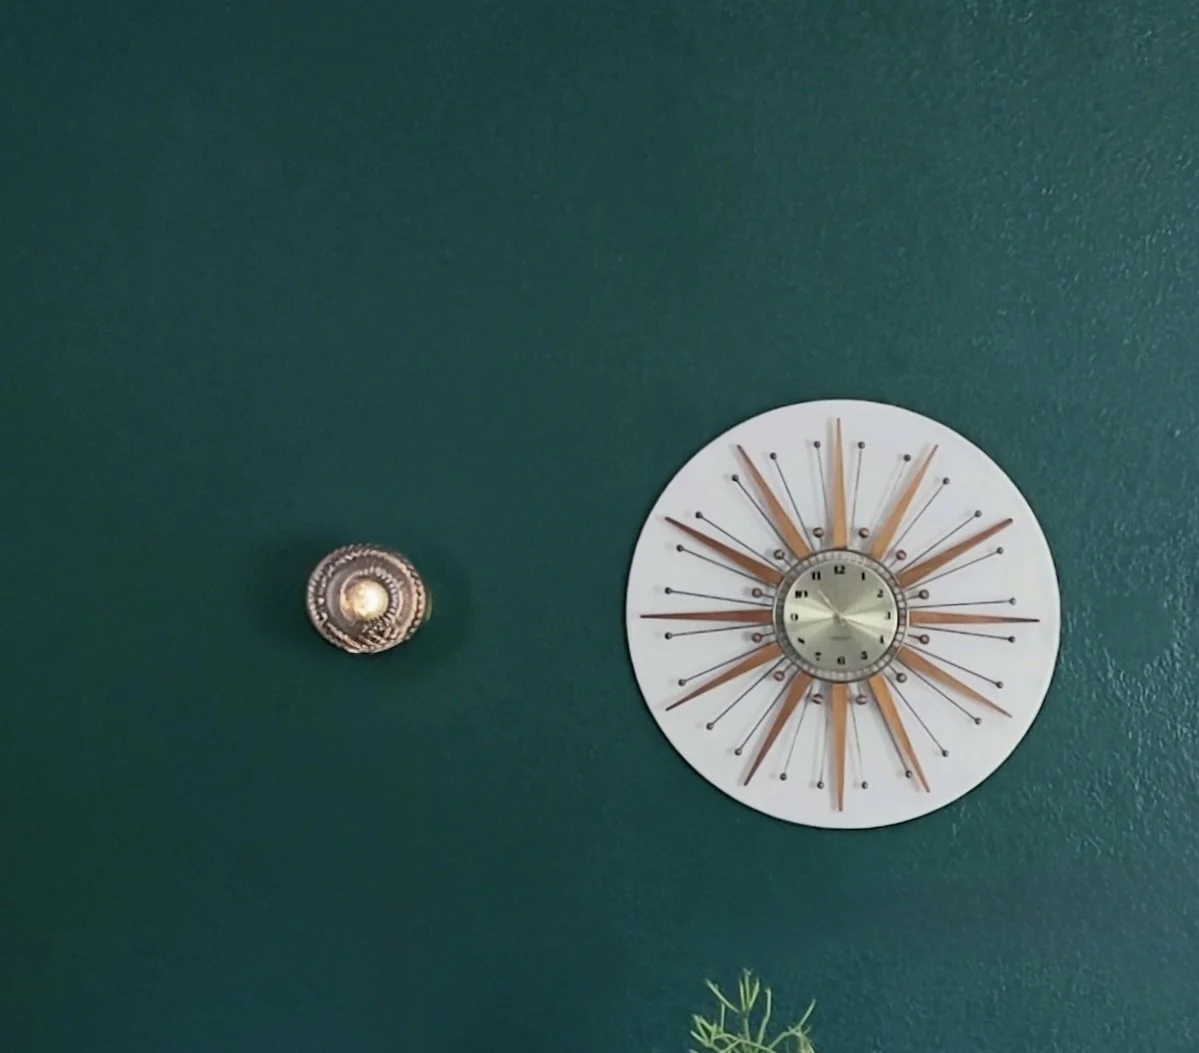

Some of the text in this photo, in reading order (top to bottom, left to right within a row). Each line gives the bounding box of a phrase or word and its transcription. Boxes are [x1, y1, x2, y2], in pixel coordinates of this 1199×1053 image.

[834, 565, 846, 575] 12
[811, 571, 821, 581] 11
[861, 572, 866, 581] 1
[876, 589, 884, 598] 2
[790, 613, 799, 622] 9
[837, 656, 846, 665] 6
